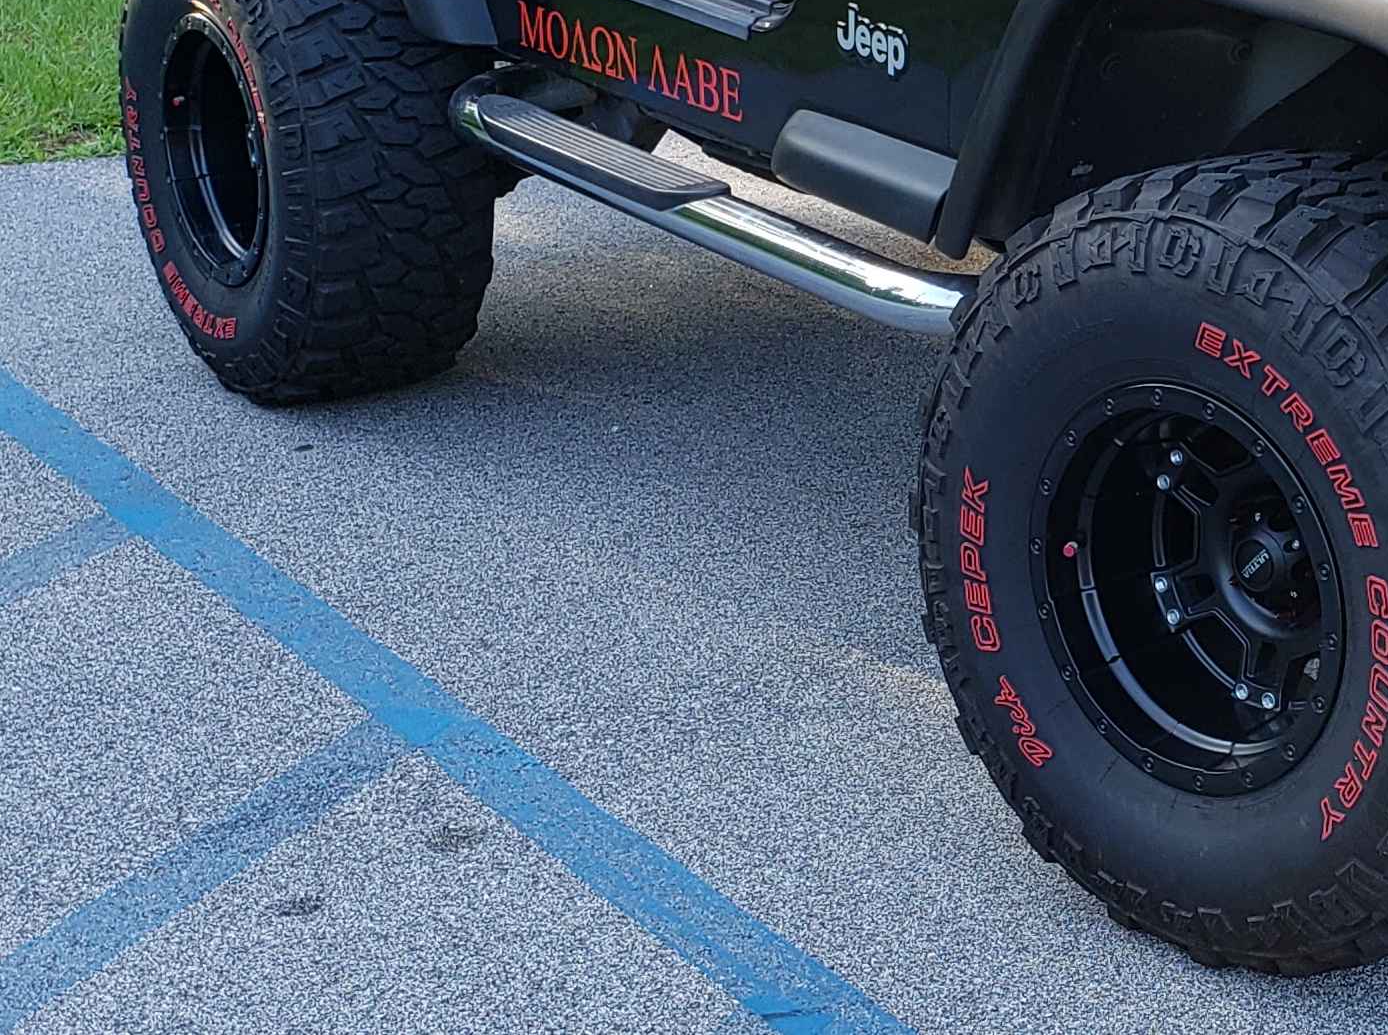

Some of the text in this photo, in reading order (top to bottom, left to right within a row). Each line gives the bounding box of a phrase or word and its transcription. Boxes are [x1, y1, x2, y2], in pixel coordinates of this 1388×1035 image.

[836, 2, 909, 76] Jeep
[125, 76, 165, 253] COUNTRY
[1195, 322, 1379, 549] EXTREME
[959, 466, 1055, 768] Dick CEPEK
